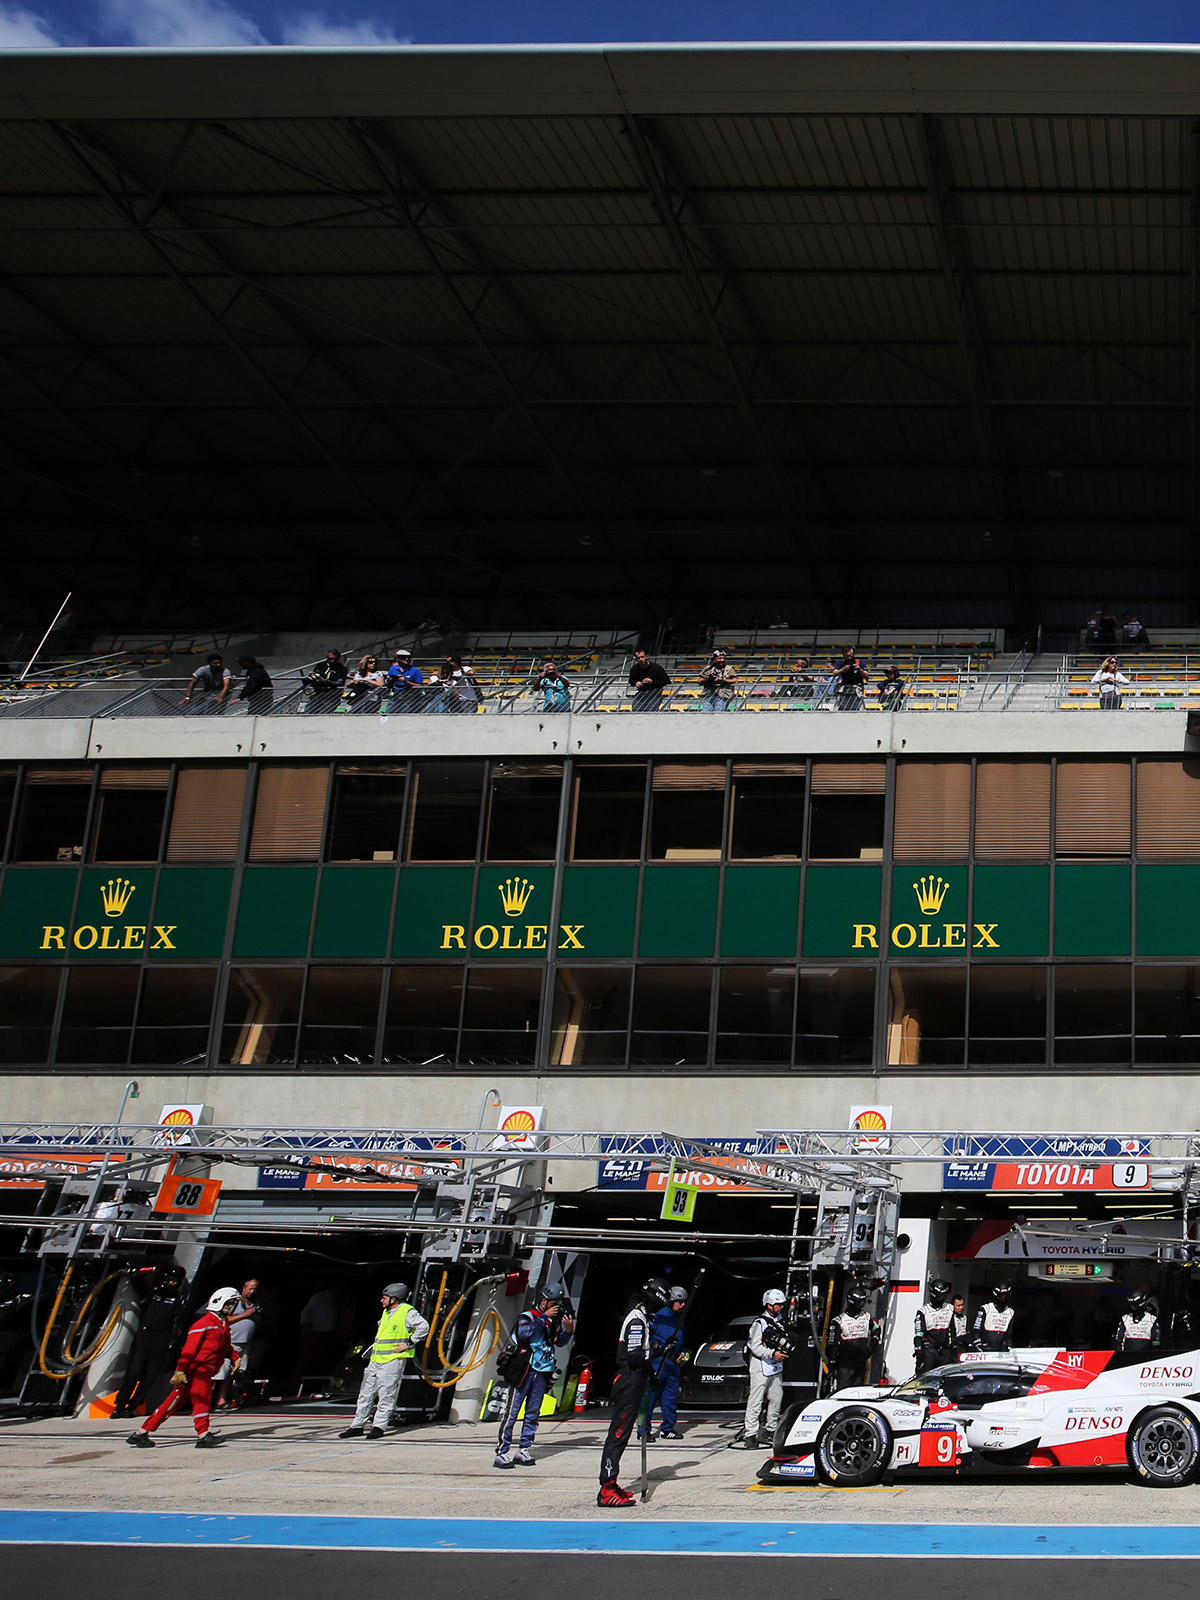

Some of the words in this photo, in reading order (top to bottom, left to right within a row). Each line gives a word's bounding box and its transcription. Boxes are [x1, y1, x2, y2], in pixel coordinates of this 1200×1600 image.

[40, 926, 176, 950] ROLEX
[440, 925, 585, 949] ROLEX
[852, 924, 1000, 948] ROLEX
[263, 1168, 275, 1176] LE
[275, 1168, 300, 1176] MANS
[614, 1170, 641, 1178] MANS
[1016, 1164, 1094, 1185] TOYOTA
[1125, 1165, 1136, 1184] 9
[175, 1184, 202, 1206] 88
[672, 1191, 688, 1213] 93
[1042, 1246, 1080, 1254] TOYOTA
[1047, 1265, 1053, 1274] 9
[1087, 1265, 1092, 1274] 9
[965, 1353, 988, 1361] ZENT
[1068, 1355, 1083, 1367] HY
[1140, 1366, 1193, 1379] DENSO
[1064, 1416, 1123, 1430] DENSO
[897, 1446, 909, 1459] P1
[937, 1435, 954, 1463] 9
[780, 1465, 814, 1474] MICHELIN
